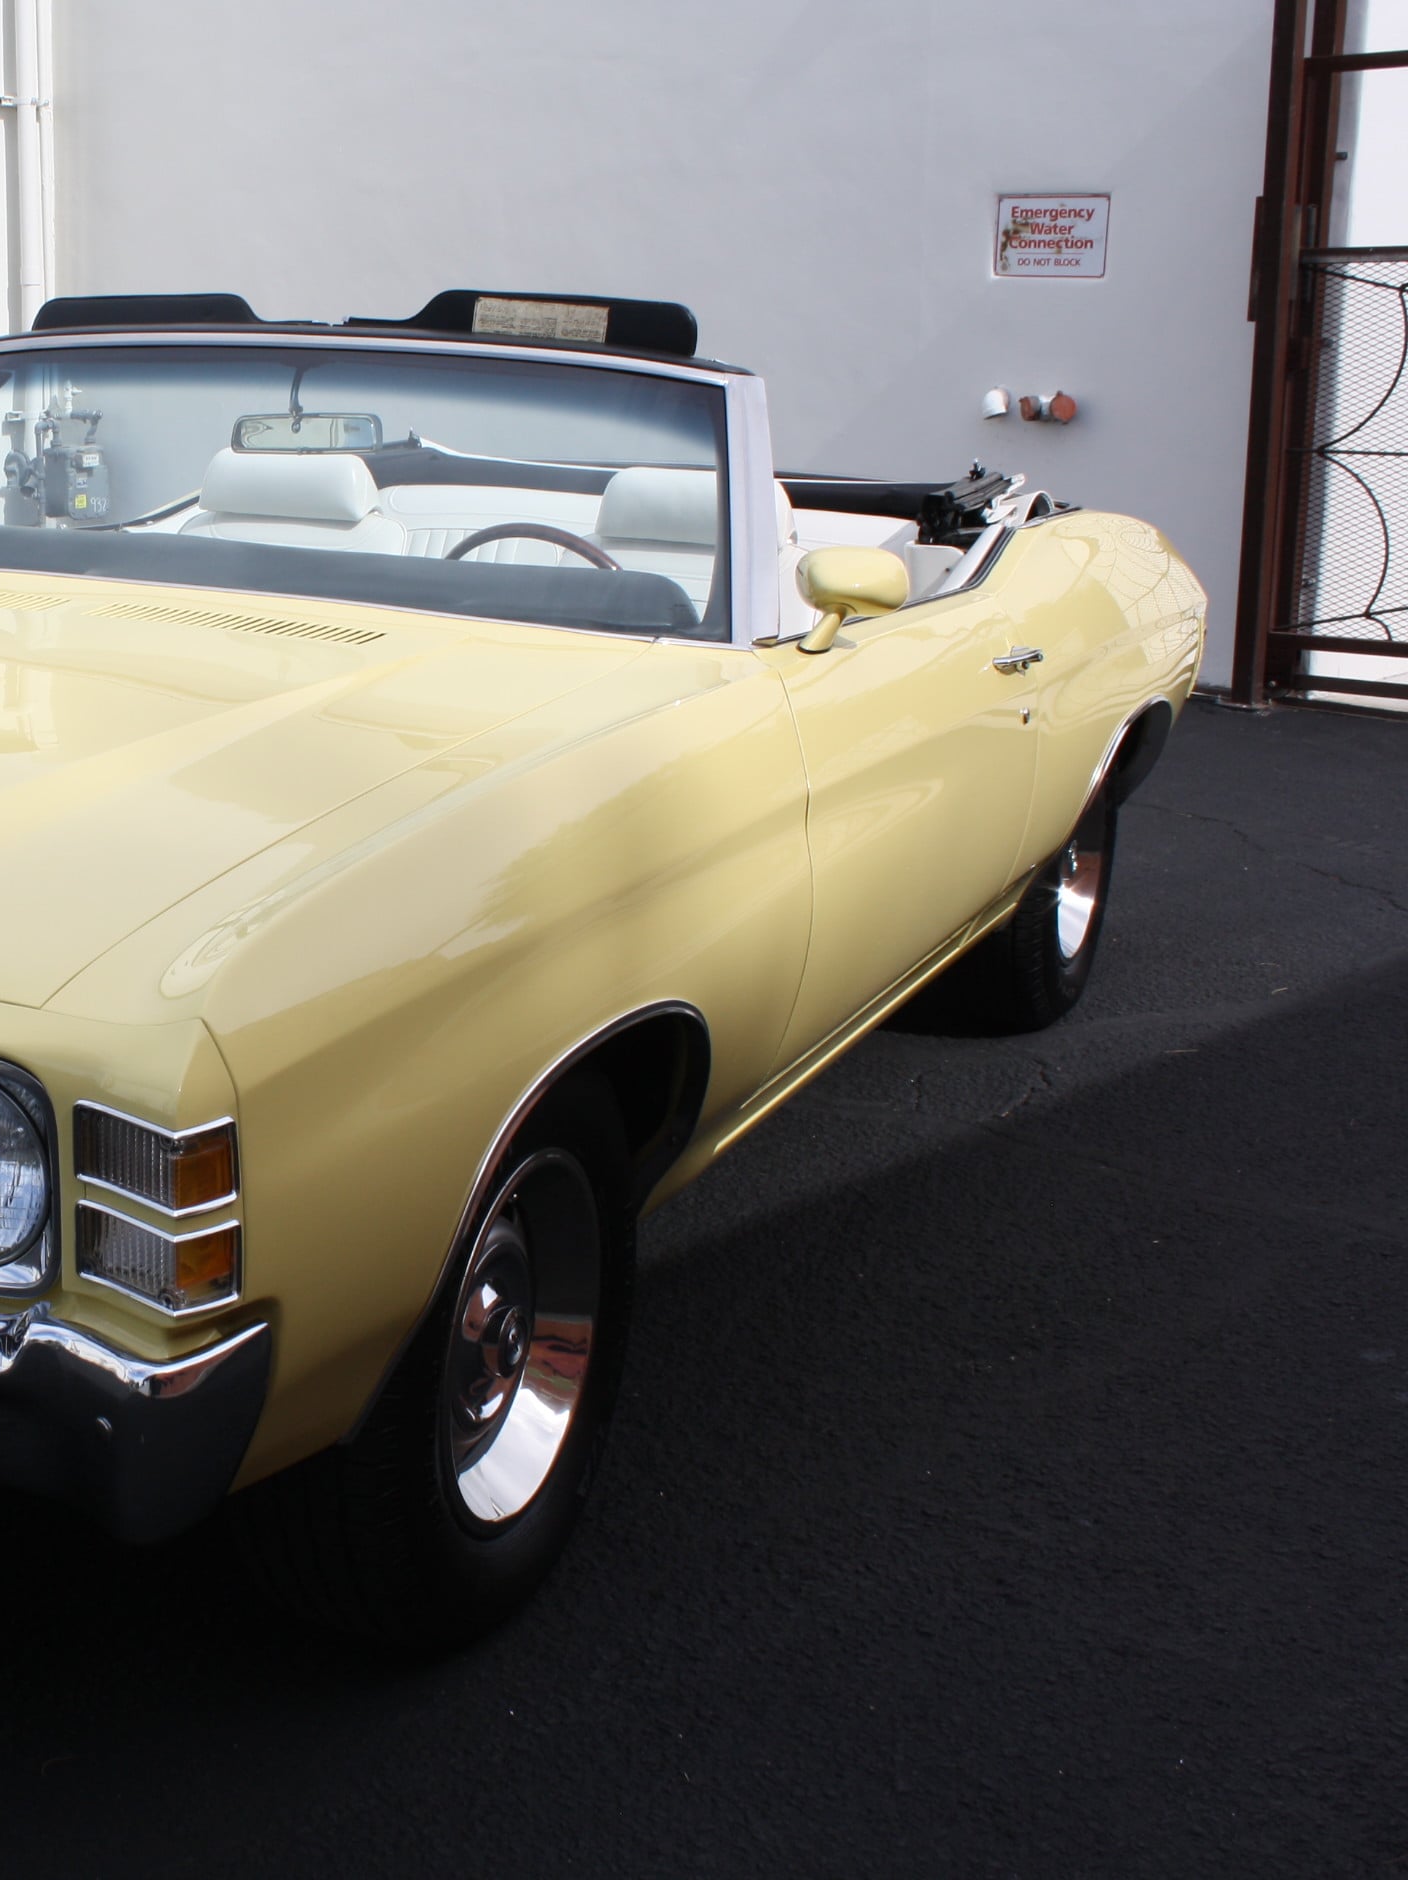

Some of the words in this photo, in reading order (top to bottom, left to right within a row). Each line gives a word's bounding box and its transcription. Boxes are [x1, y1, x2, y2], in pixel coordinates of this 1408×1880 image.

[1011, 206, 1095, 221] Emergency
[1030, 222, 1075, 235] Water
[1009, 236, 1094, 249] Connection
[1017, 258, 1030, 266] DO
[1033, 258, 1051, 266] NOT
[1054, 258, 1080, 266] BLOCK
